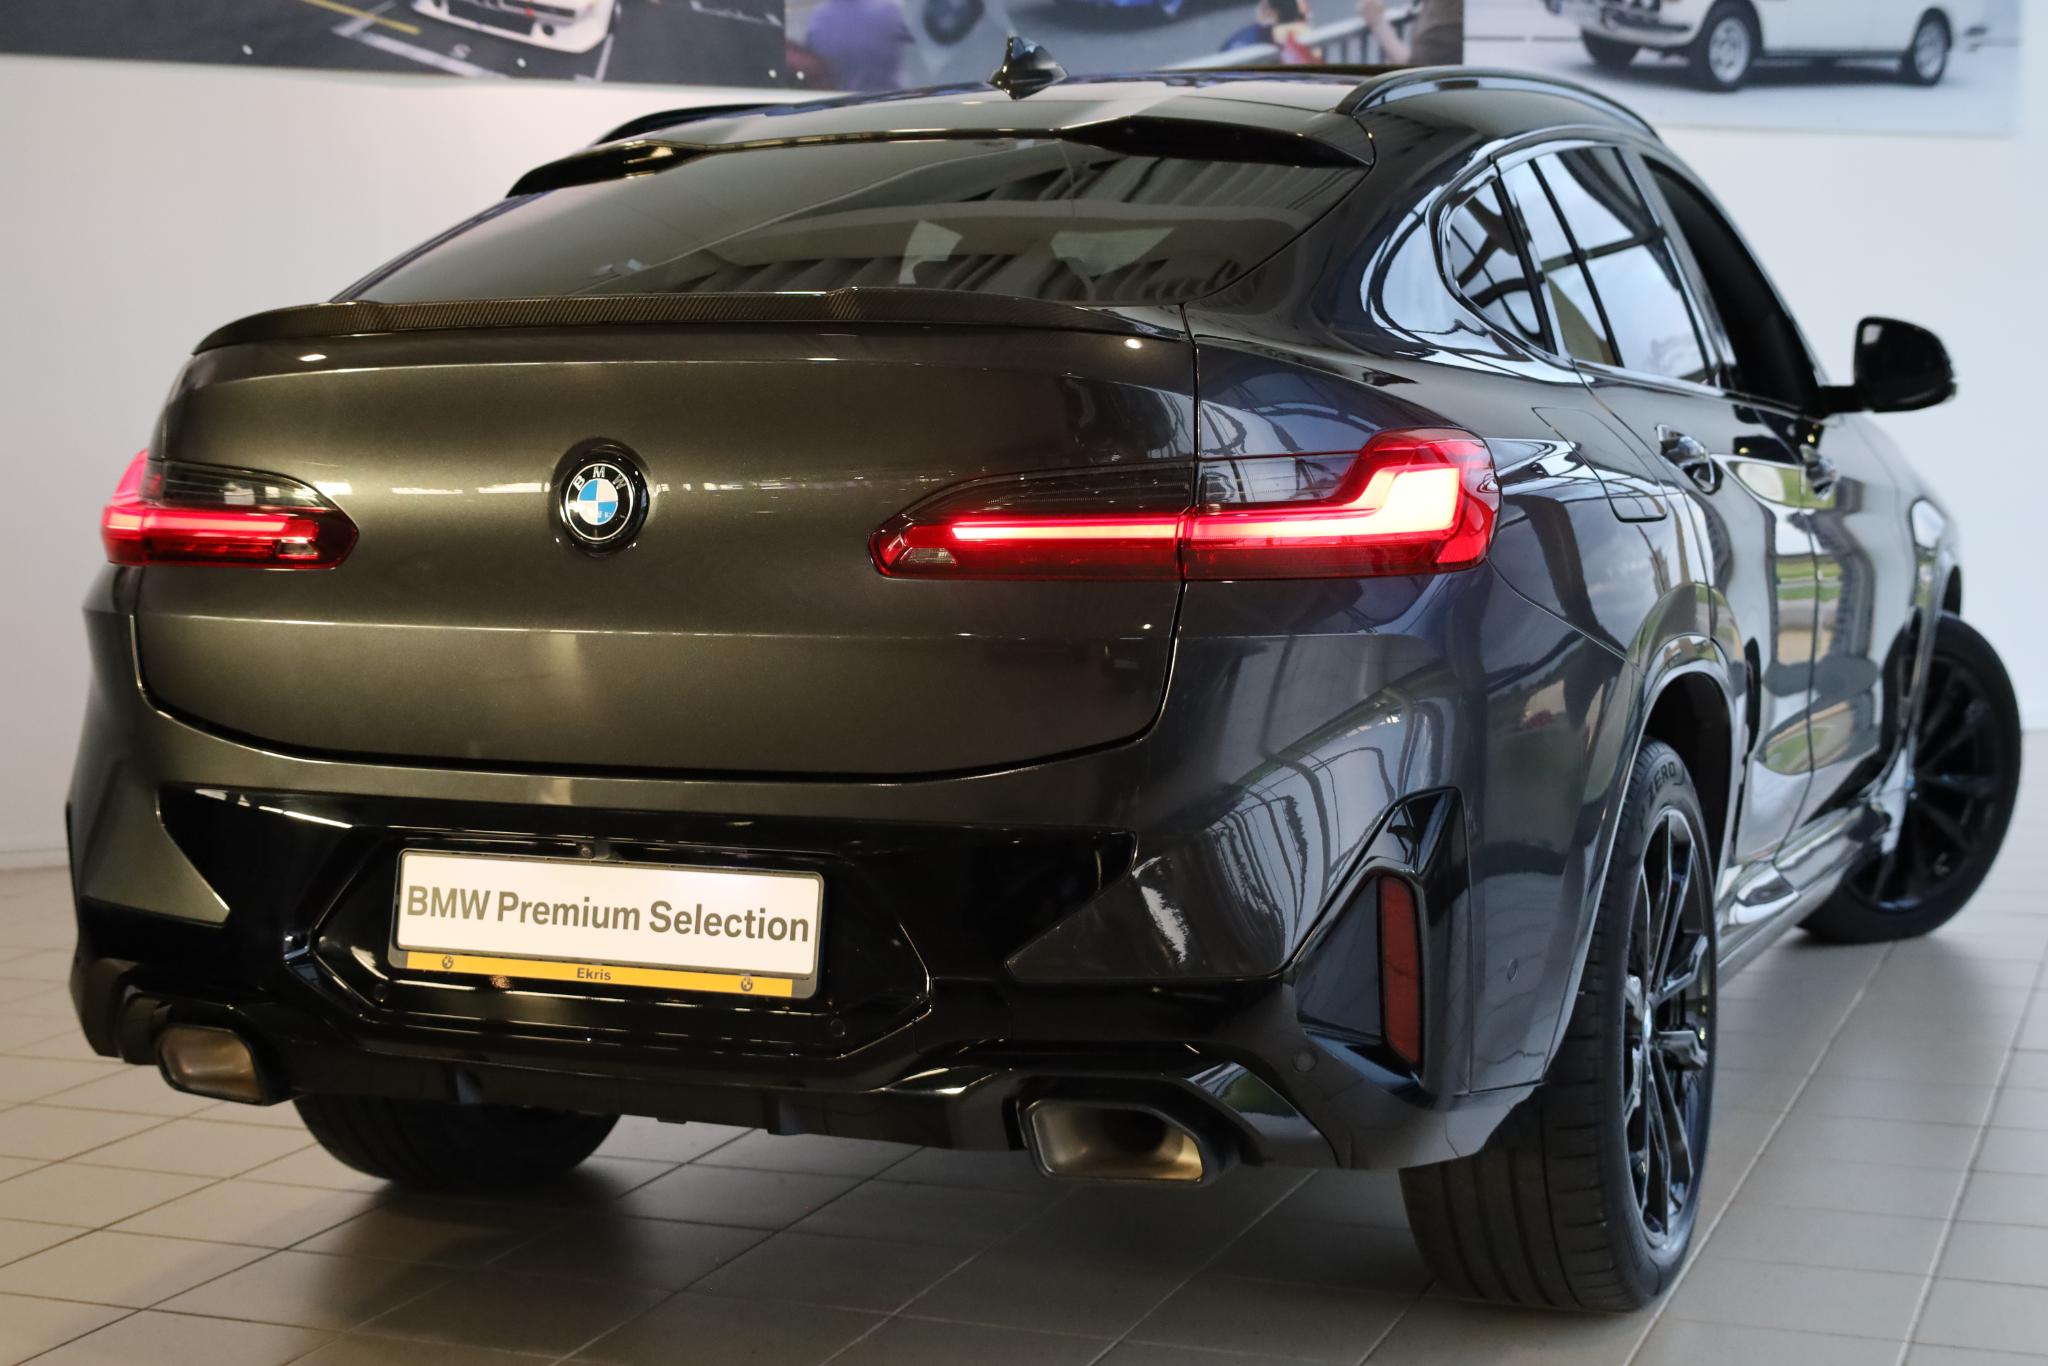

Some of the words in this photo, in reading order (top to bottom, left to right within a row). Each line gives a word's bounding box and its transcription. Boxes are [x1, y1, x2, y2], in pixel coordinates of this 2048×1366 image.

[573, 466, 626, 491] BMW
[407, 885, 490, 921] BMW
[498, 891, 640, 931] Premium
[649, 900, 809, 942] Selection
[576, 966, 612, 982] Ekris
